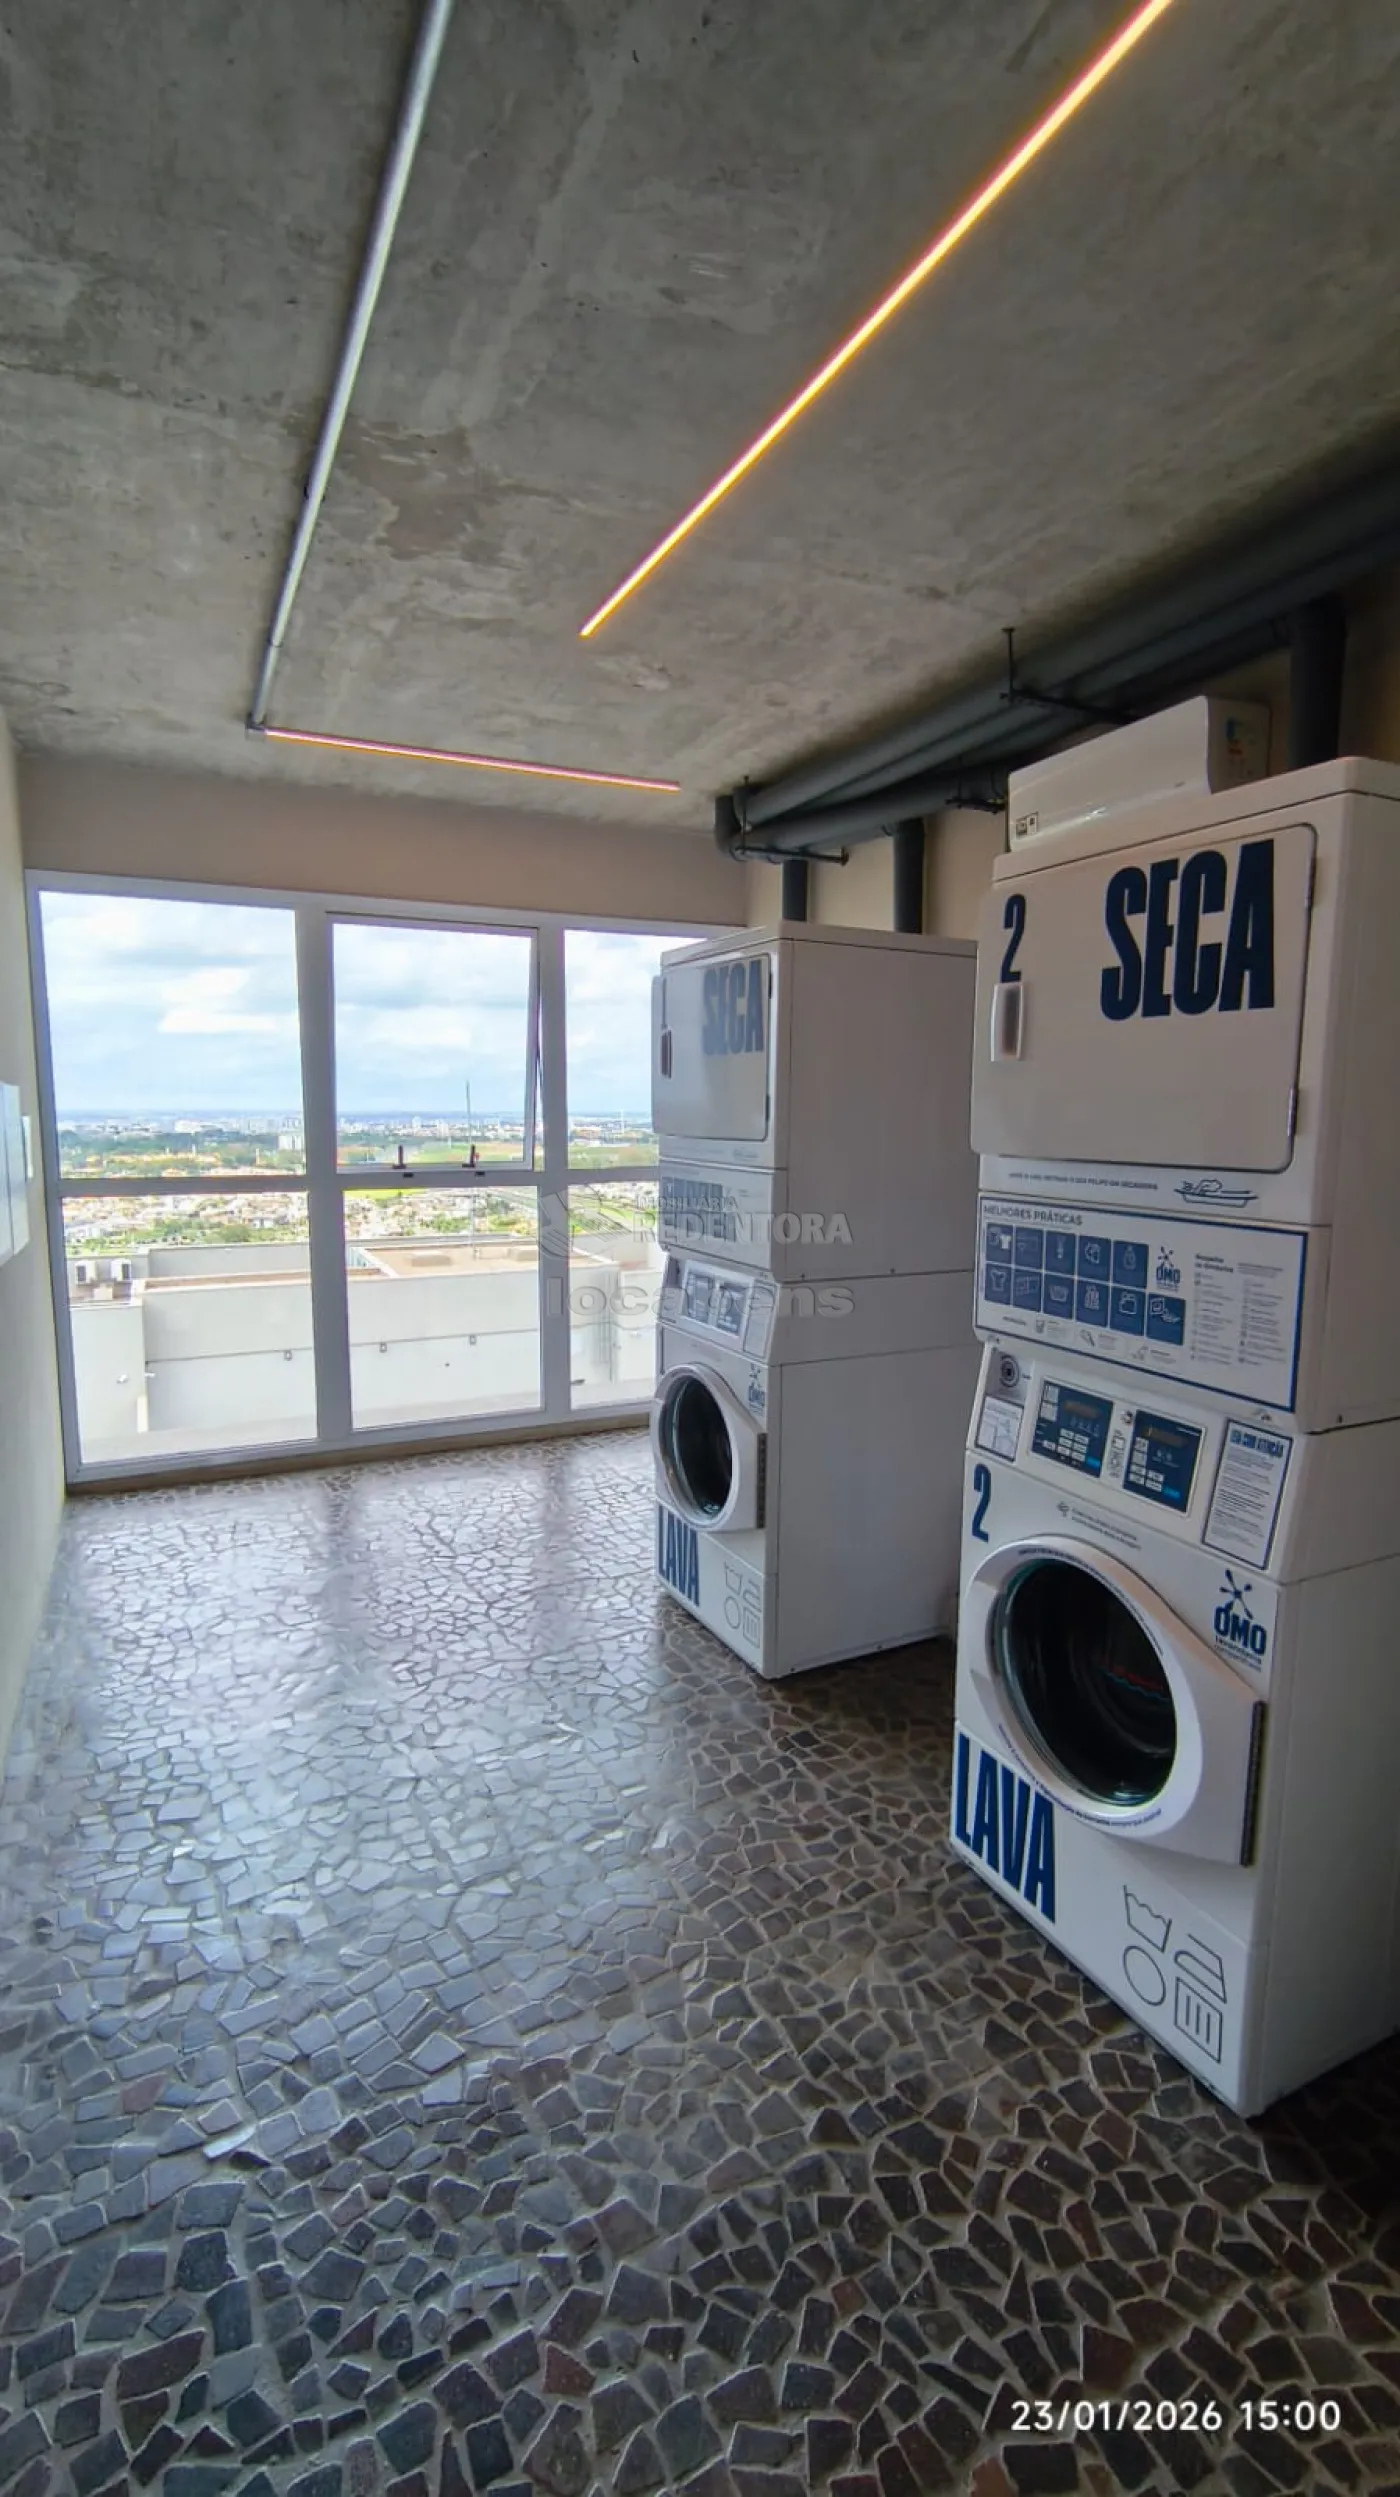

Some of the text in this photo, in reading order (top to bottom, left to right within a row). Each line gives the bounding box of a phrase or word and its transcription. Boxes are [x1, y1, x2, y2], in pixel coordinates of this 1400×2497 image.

[1001, 893, 1027, 982] 2
[1100, 838, 1275, 1021] SECA
[702, 960, 764, 1055] SECA
[971, 1463, 991, 1543] 2
[658, 1503, 700, 1607] LAVA
[1213, 1605, 1267, 1655] OMO
[955, 1731, 1056, 1924] LAVA
